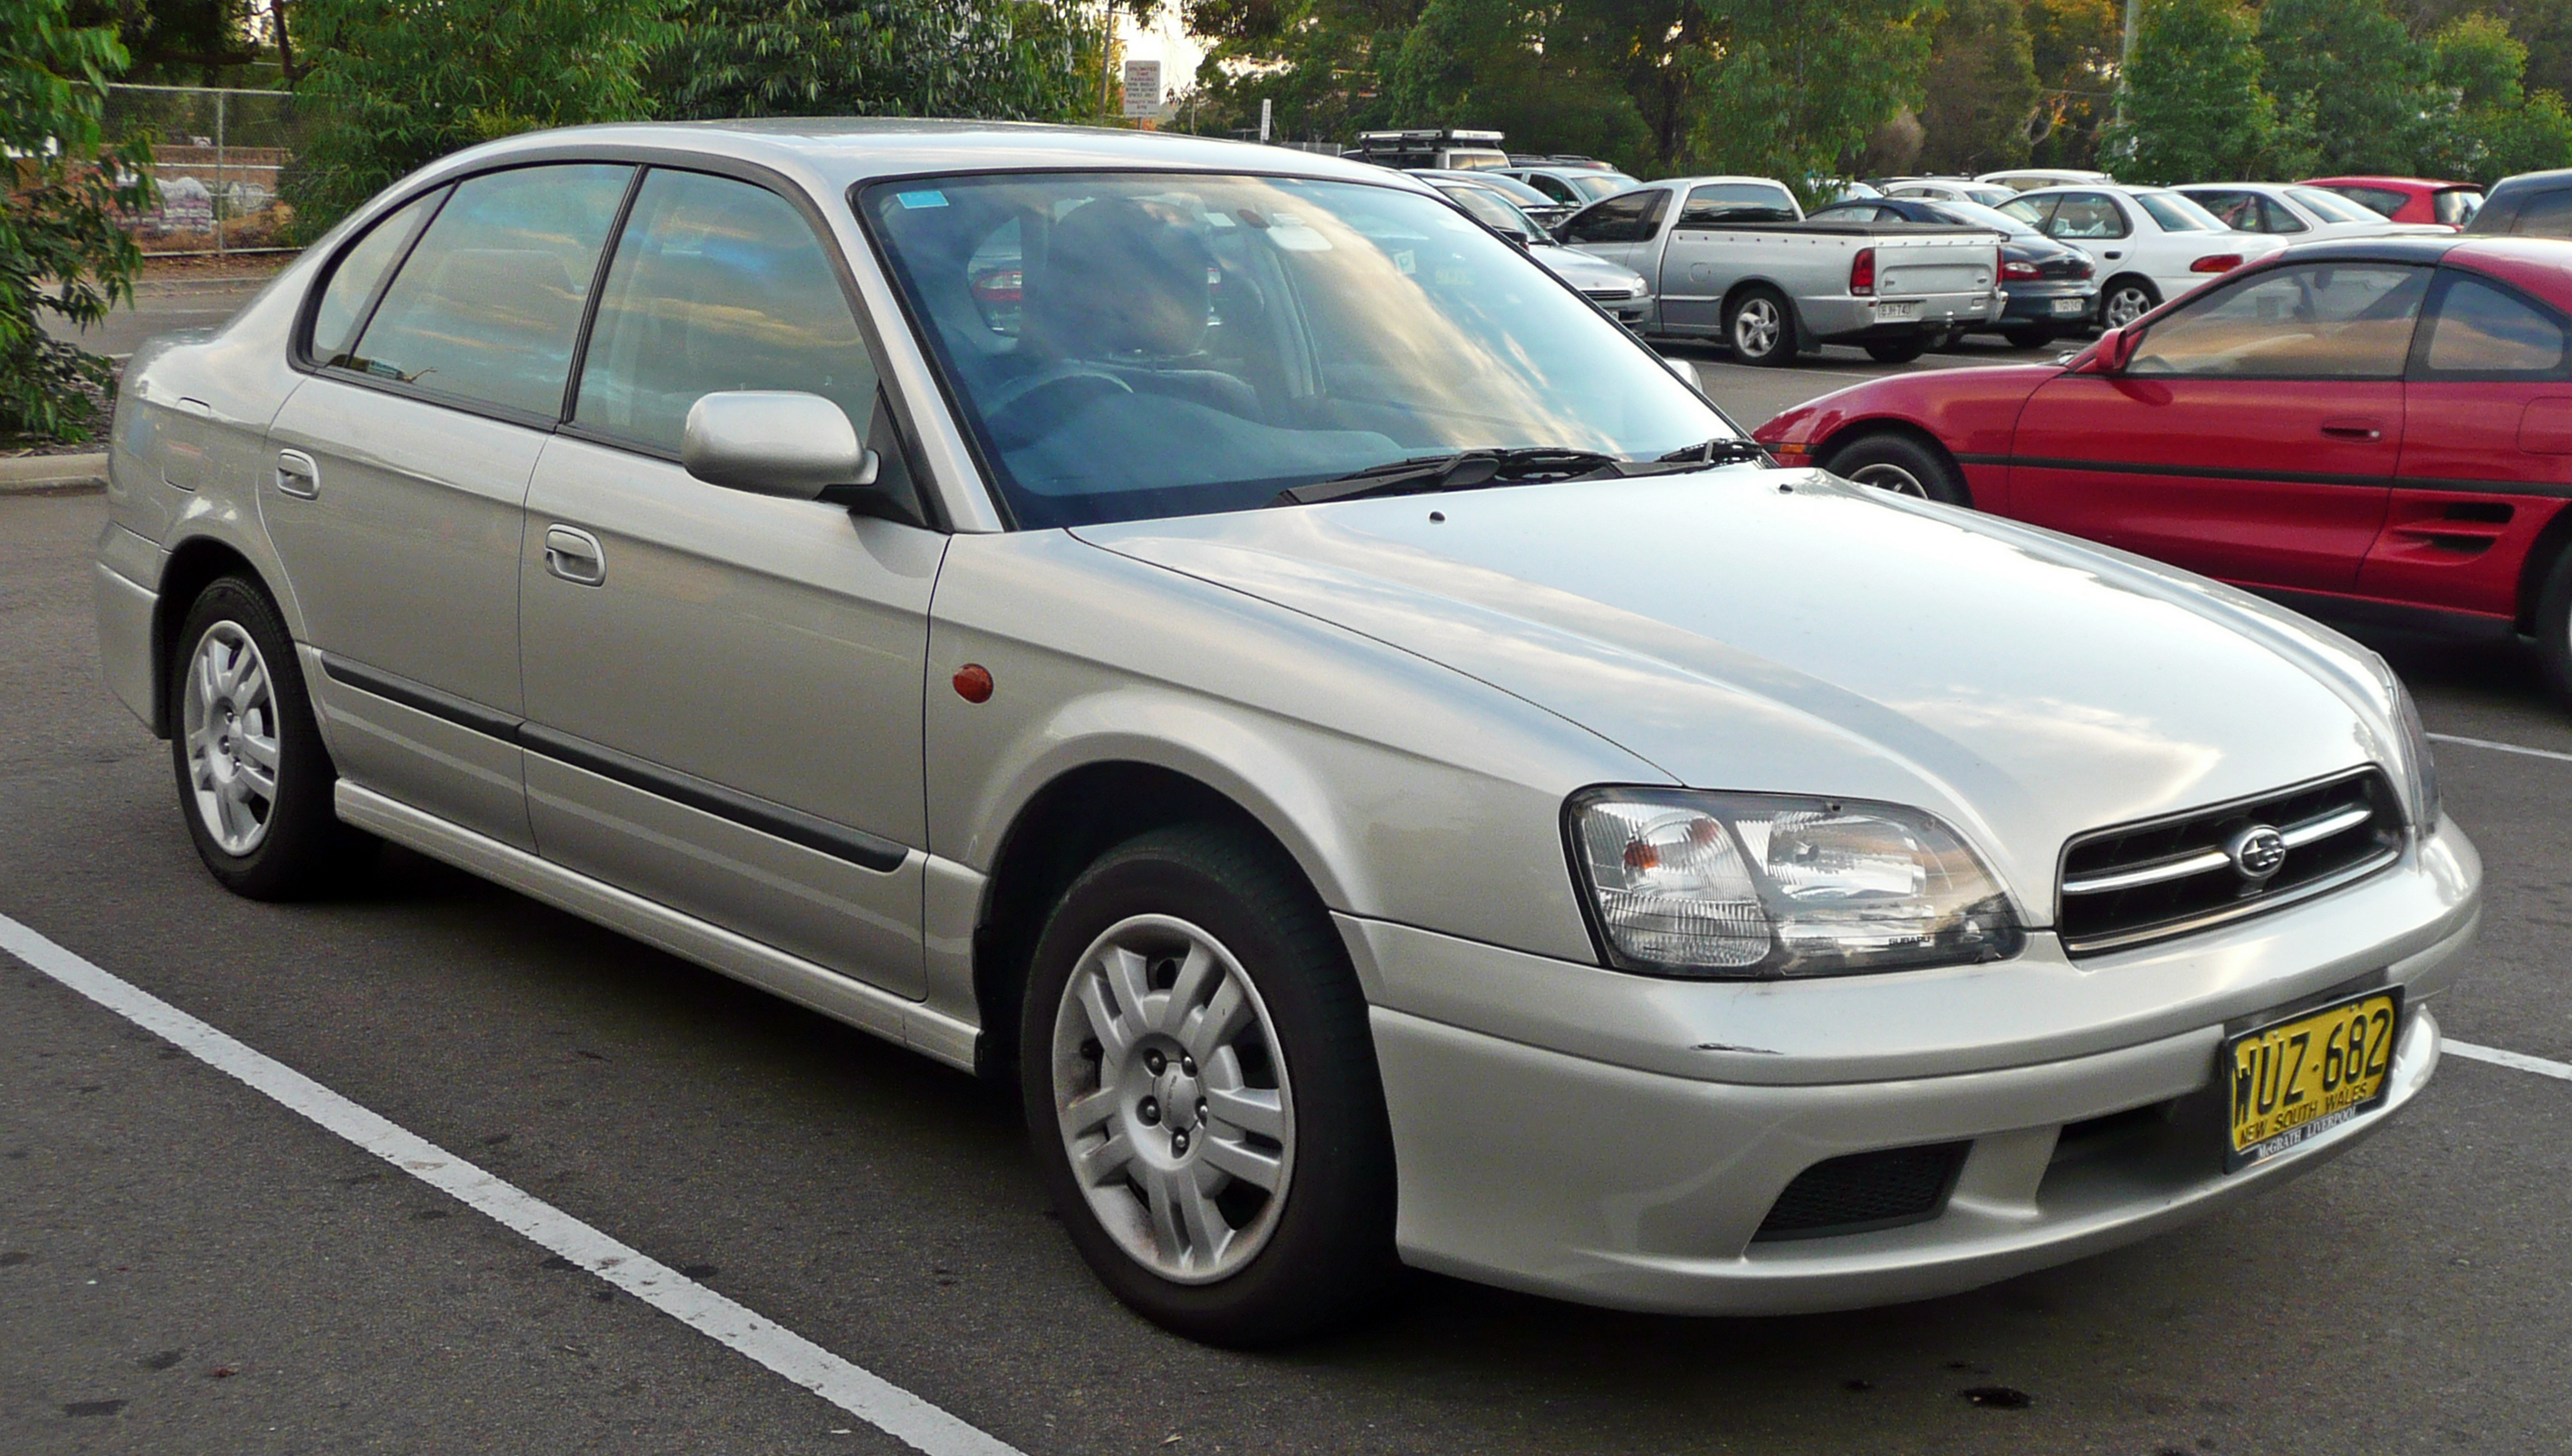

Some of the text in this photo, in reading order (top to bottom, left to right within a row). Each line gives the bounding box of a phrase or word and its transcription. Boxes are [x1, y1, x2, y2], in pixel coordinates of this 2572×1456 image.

[1888, 936, 1930, 945] SUBARU
[2241, 1082, 2367, 1145] NEW SOUTH WALES
[2308, 1106, 2357, 1138] LIVERPOOL
